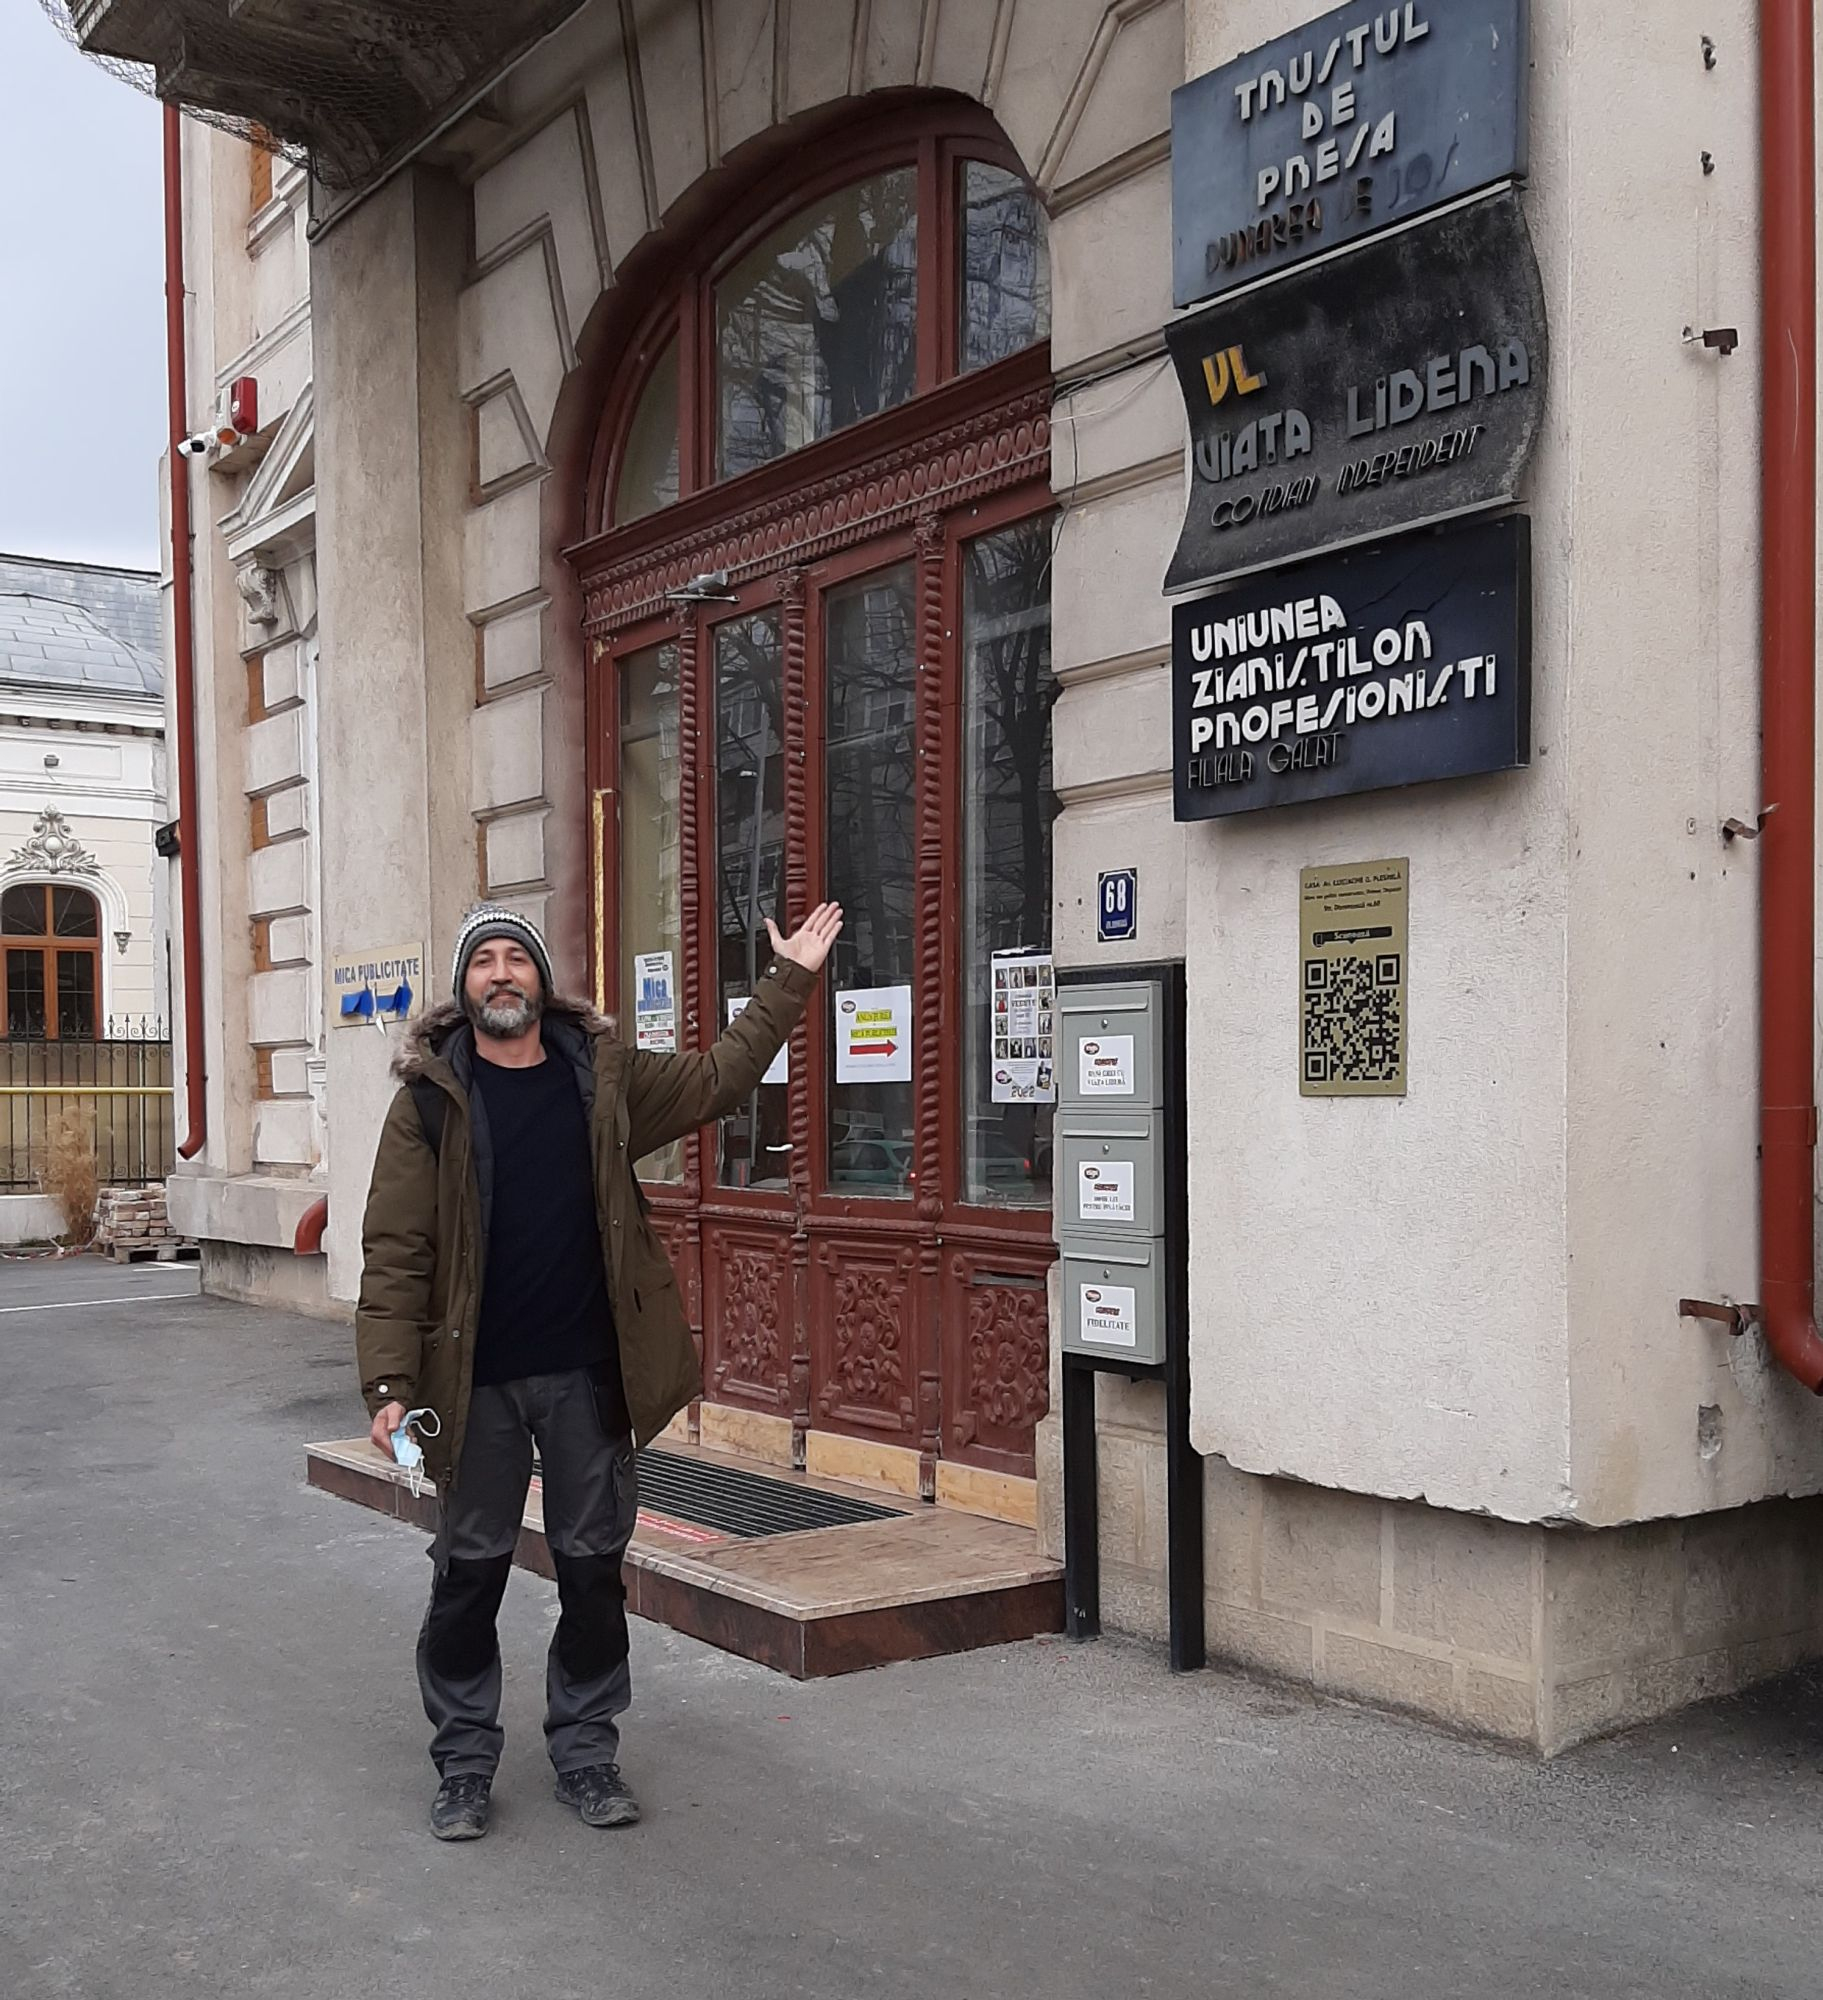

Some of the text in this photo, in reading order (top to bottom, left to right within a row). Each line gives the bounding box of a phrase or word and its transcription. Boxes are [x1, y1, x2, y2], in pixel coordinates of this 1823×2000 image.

[1302, 80, 1356, 139] DE
[1257, 110, 1396, 206] PRESA
[1336, 424, 1486, 495] INDEPENDENT
[1191, 594, 1347, 663] UNIUNEA
[1187, 750, 1254, 790] FILIALA
[1104, 878, 1128, 914] 68
[334, 957, 420, 985] MICA PUBLICITATE
[642, 977, 668, 1000] Mica
[1010, 1085, 1036, 1098] 2022
[1086, 1317, 1131, 1332] FIDELITATE
